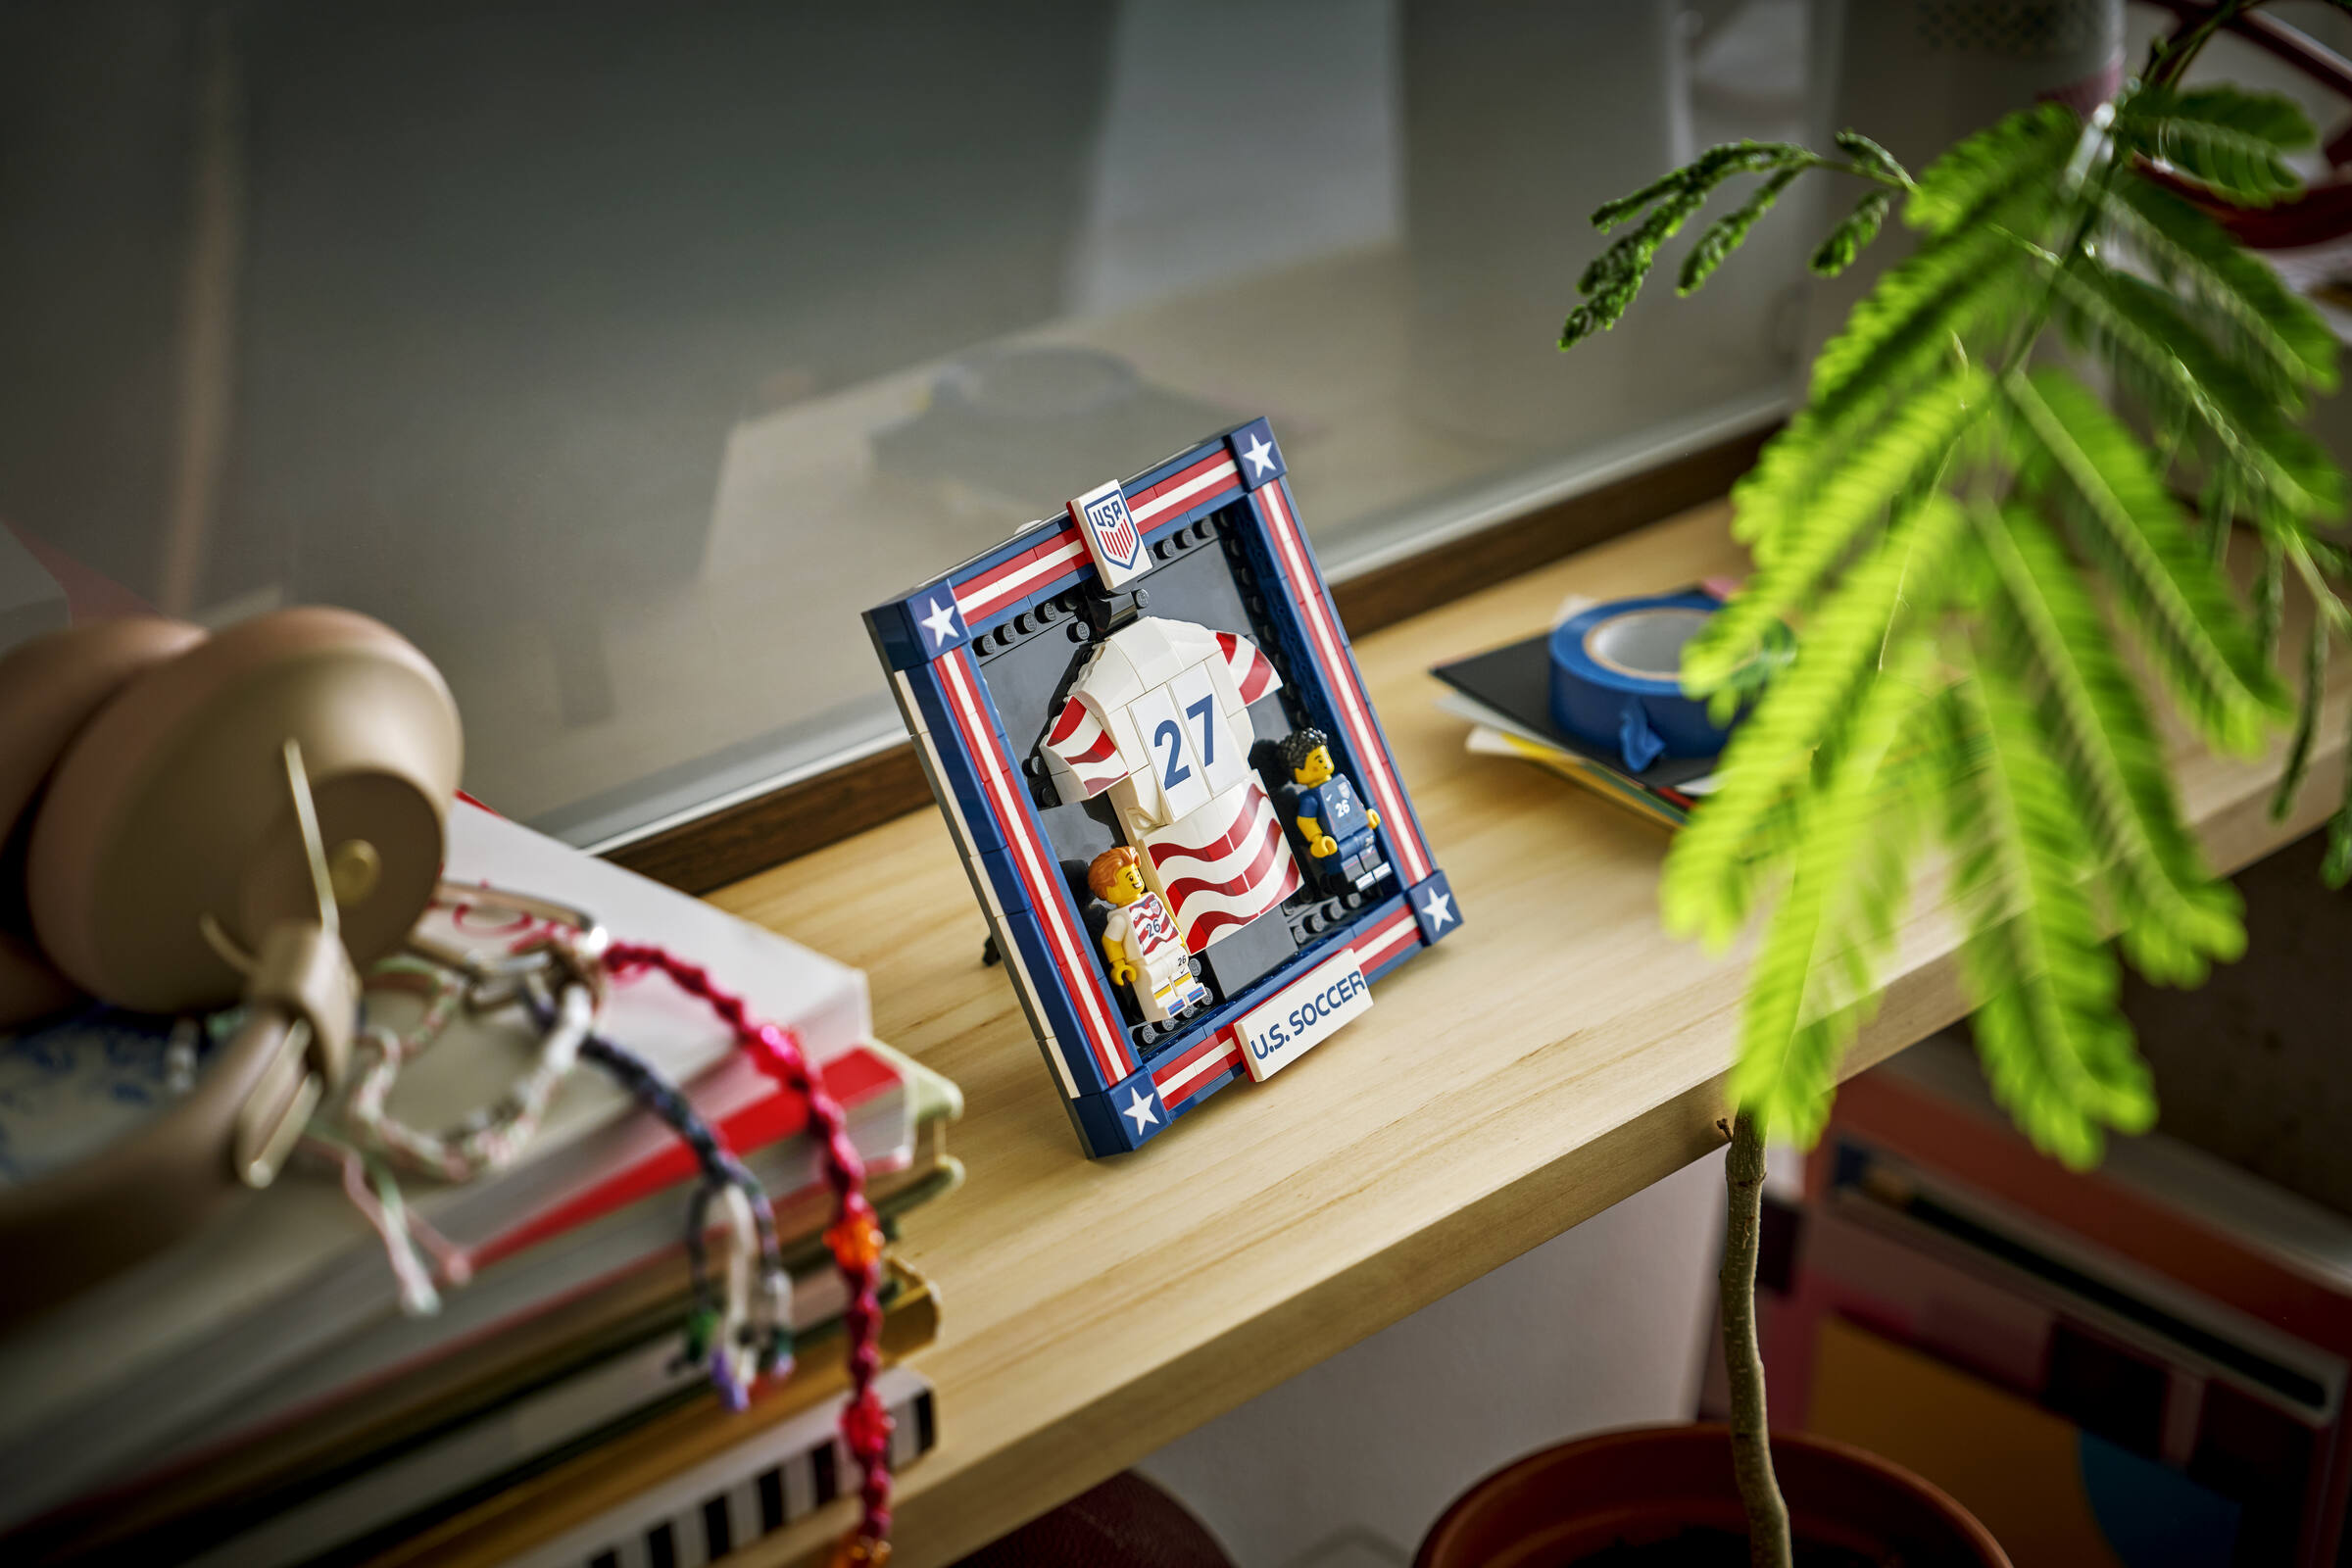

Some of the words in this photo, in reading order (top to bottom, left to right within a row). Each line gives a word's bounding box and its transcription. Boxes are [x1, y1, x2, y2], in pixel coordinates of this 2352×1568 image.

[1093, 501, 1122, 527] USA
[1154, 693, 1213, 791] 27
[1335, 800, 1350, 818] 26
[1146, 919, 1161, 938] 26
[1178, 956, 1187, 966] 26
[1250, 1023, 1290, 1059] U.S.
[1289, 970, 1365, 1036] SOCCER
